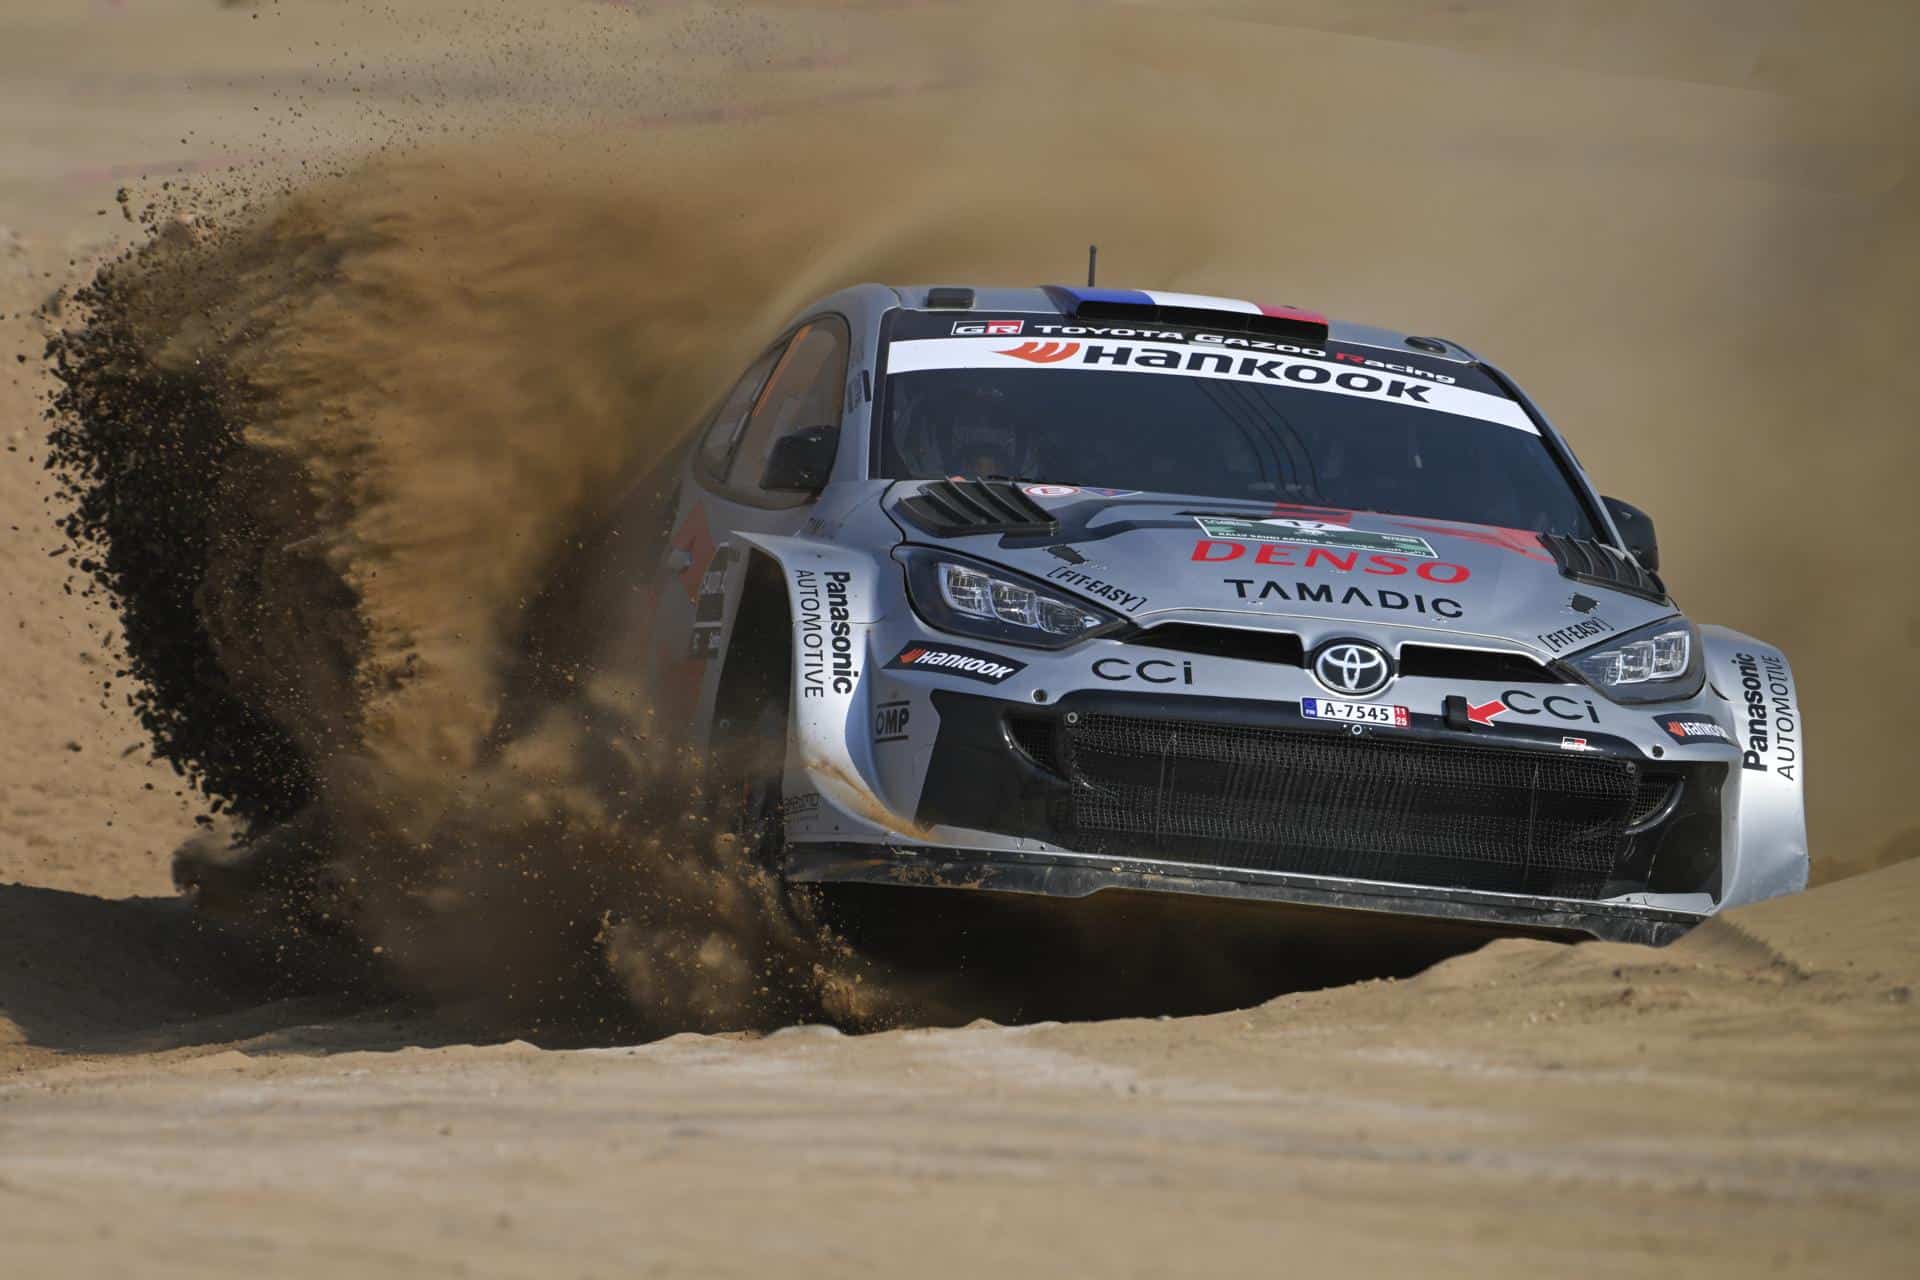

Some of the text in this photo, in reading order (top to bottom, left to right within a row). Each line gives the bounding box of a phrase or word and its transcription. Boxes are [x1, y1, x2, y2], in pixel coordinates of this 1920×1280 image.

[954, 325, 1456, 384] GR TOYOTA GAZOO Racing
[1191, 540, 1471, 584] DENSO
[1224, 578, 1464, 618] TAMADIC
[795, 569, 824, 698] AUTOMOTIVE
[824, 571, 859, 694] Panasonic
[875, 707, 910, 735] OMP
[1324, 703, 1389, 721] A-7545
[1731, 652, 1768, 772] Panasonic
[1761, 655, 1795, 781] AUTOMOTIVE
